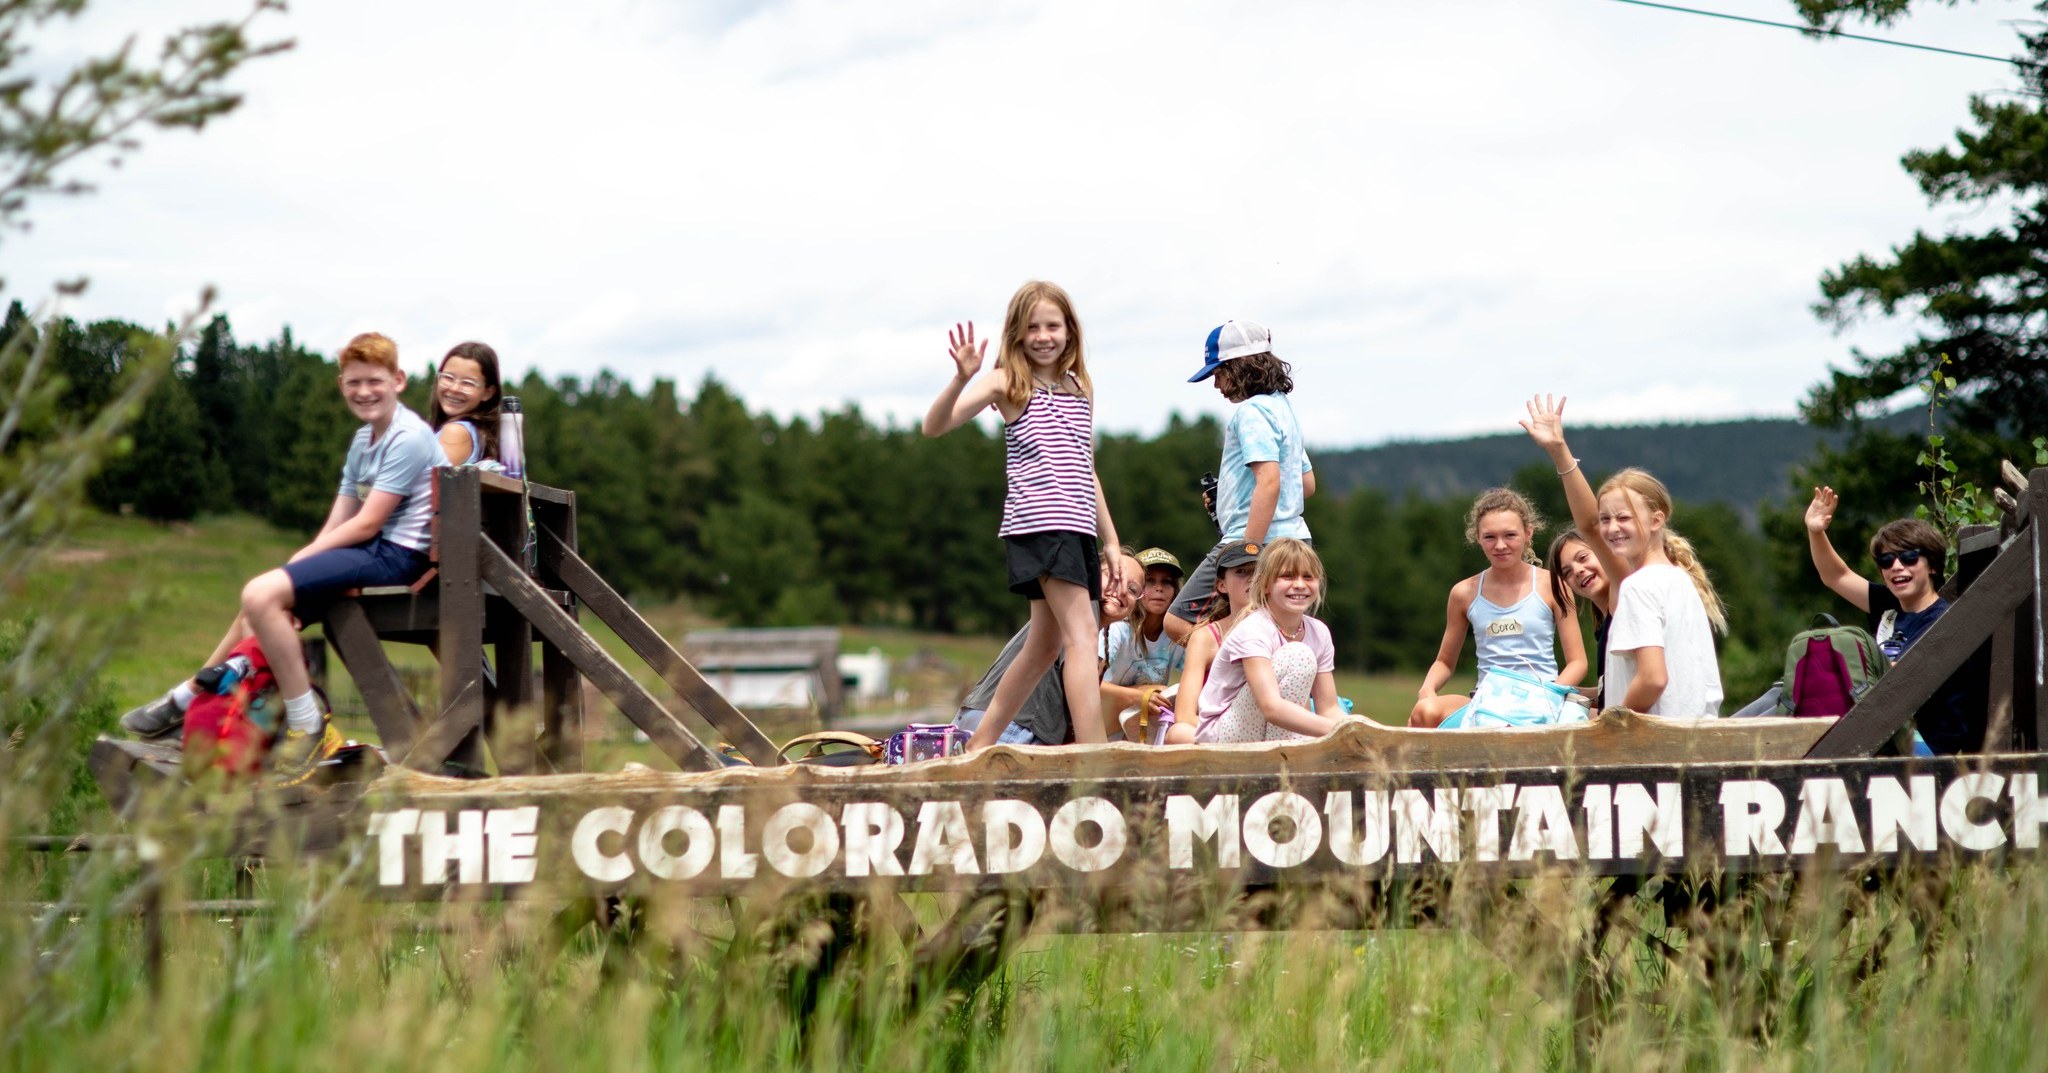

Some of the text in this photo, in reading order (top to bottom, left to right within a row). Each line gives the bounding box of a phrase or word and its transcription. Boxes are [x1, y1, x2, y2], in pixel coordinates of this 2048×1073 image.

[366, 805, 539, 887] THE
[571, 795, 1128, 883] COLORADO
[1164, 782, 1685, 870] MOUNTAIN
